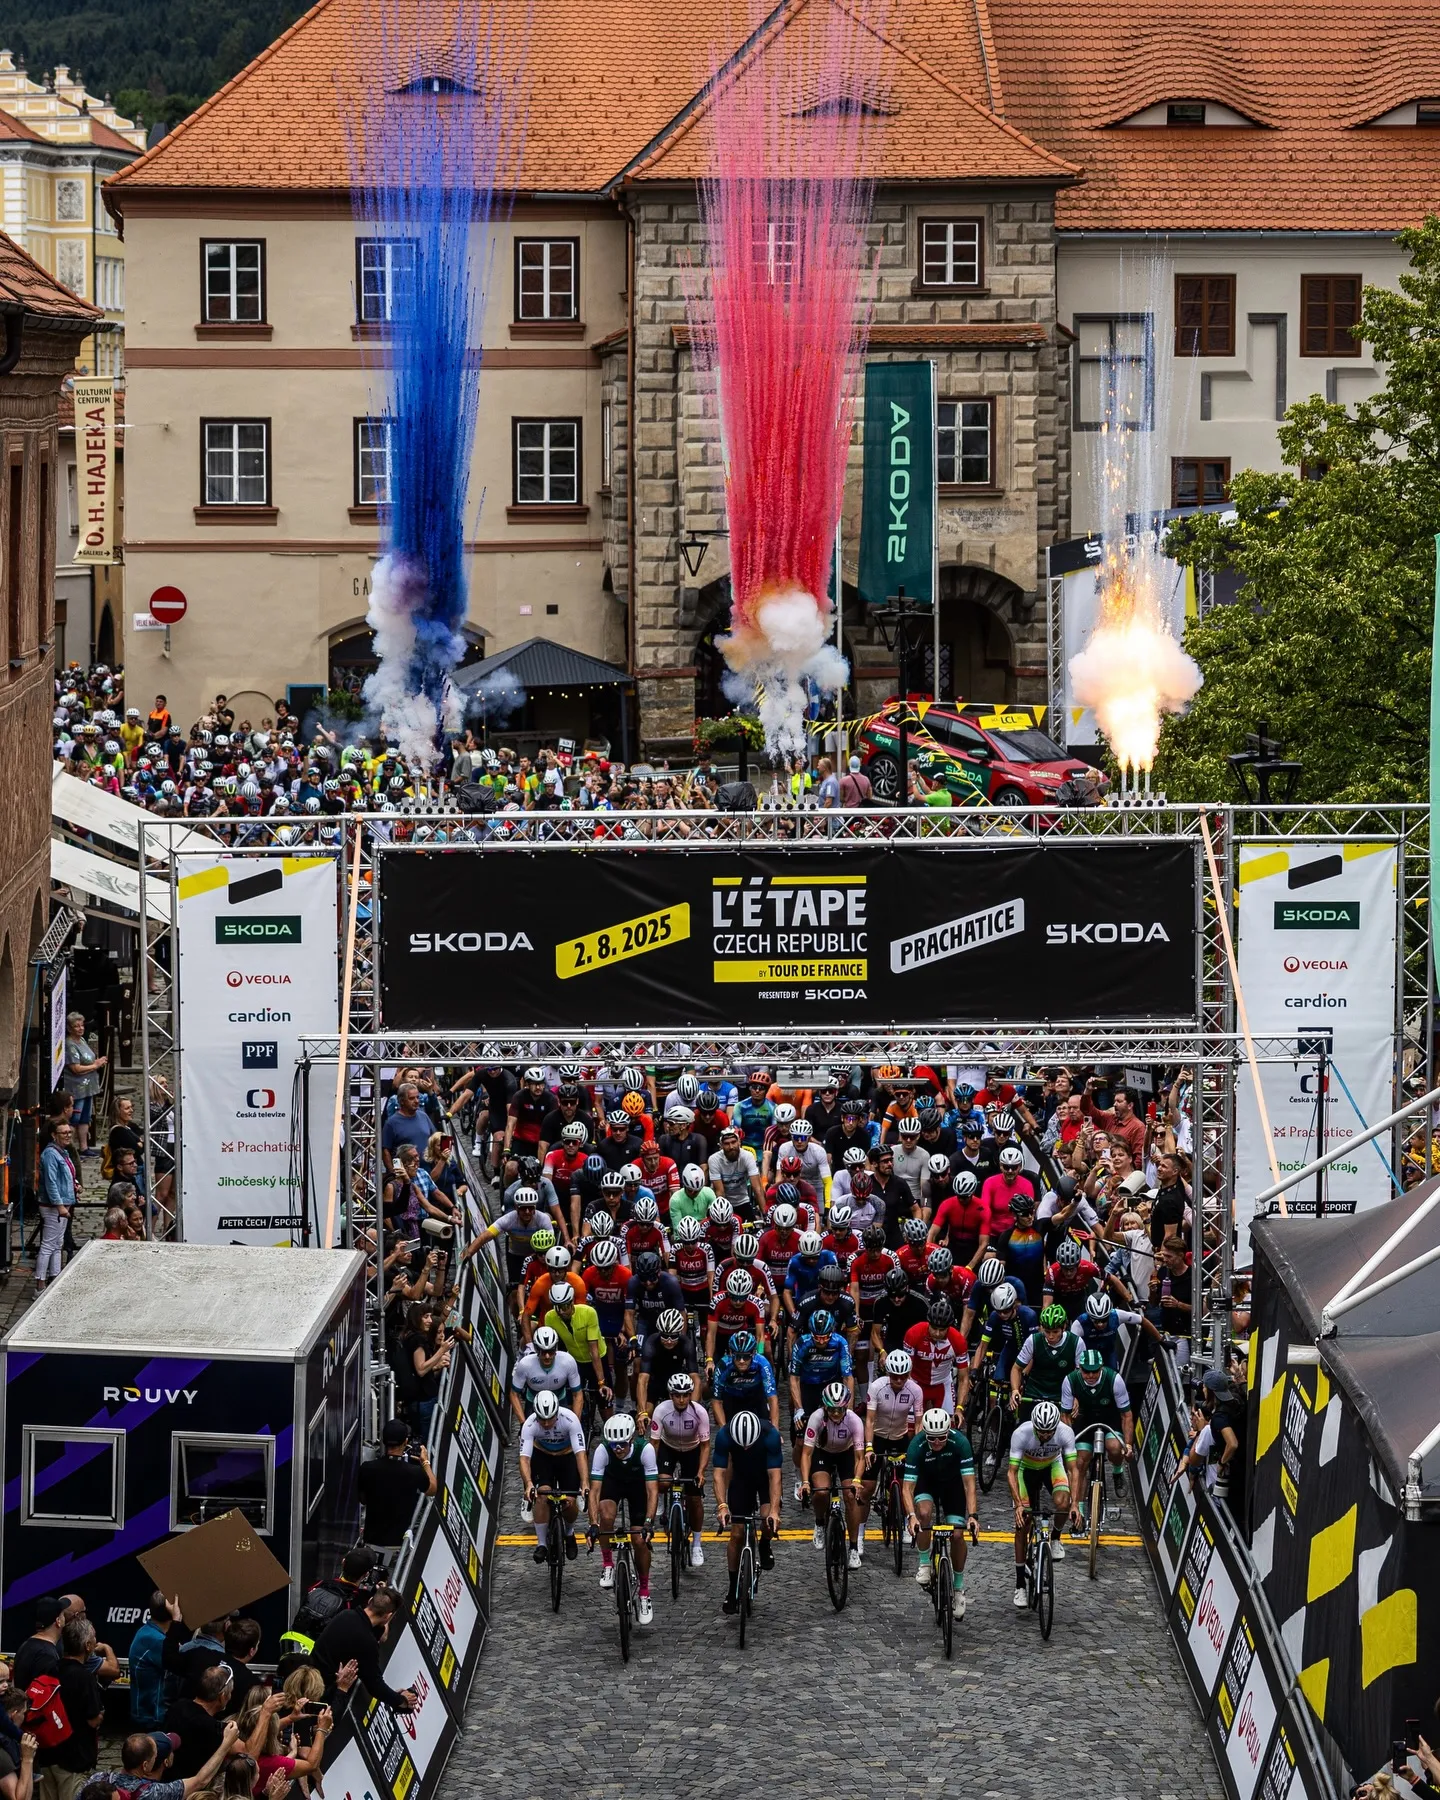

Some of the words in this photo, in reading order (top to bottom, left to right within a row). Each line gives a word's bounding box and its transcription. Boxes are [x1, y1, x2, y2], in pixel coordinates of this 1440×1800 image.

[76, 386, 112, 396] KULTURNÍ
[1001, 716, 1017, 724] LCL
[622, 913, 672, 953] 2025
[901, 905, 1015, 967] PRACHATICE
[713, 934, 770, 954] CZECH
[777, 932, 867, 953] REPUBLIC
[768, 964, 799, 977] TOUR
[801, 964, 815, 976] DE
[818, 963, 863, 976] FRANCE
[1302, 960, 1348, 970] VEOLIA
[246, 975, 291, 985] VEOLIA
[758, 991, 791, 999] PRESENTED
[791, 991, 799, 999] BY
[1285, 993, 1347, 1008] cardion
[228, 1007, 291, 1022] cardion
[246, 1045, 275, 1057] PPF
[1289, 1126, 1353, 1137] Pracatice
[1330, 1161, 1351, 1173] kraj
[217, 1175, 276, 1188] Jihočeský
[1295, 1201, 1316, 1211] ČECH
[1324, 1203, 1352, 1211] SPORT
[222, 1218, 243, 1227] PETR
[245, 1217, 267, 1227] ČECH
[274, 1218, 303, 1227] SPORT
[103, 1386, 198, 1404] ROUVY
[107, 1606, 141, 1623] KEEP
